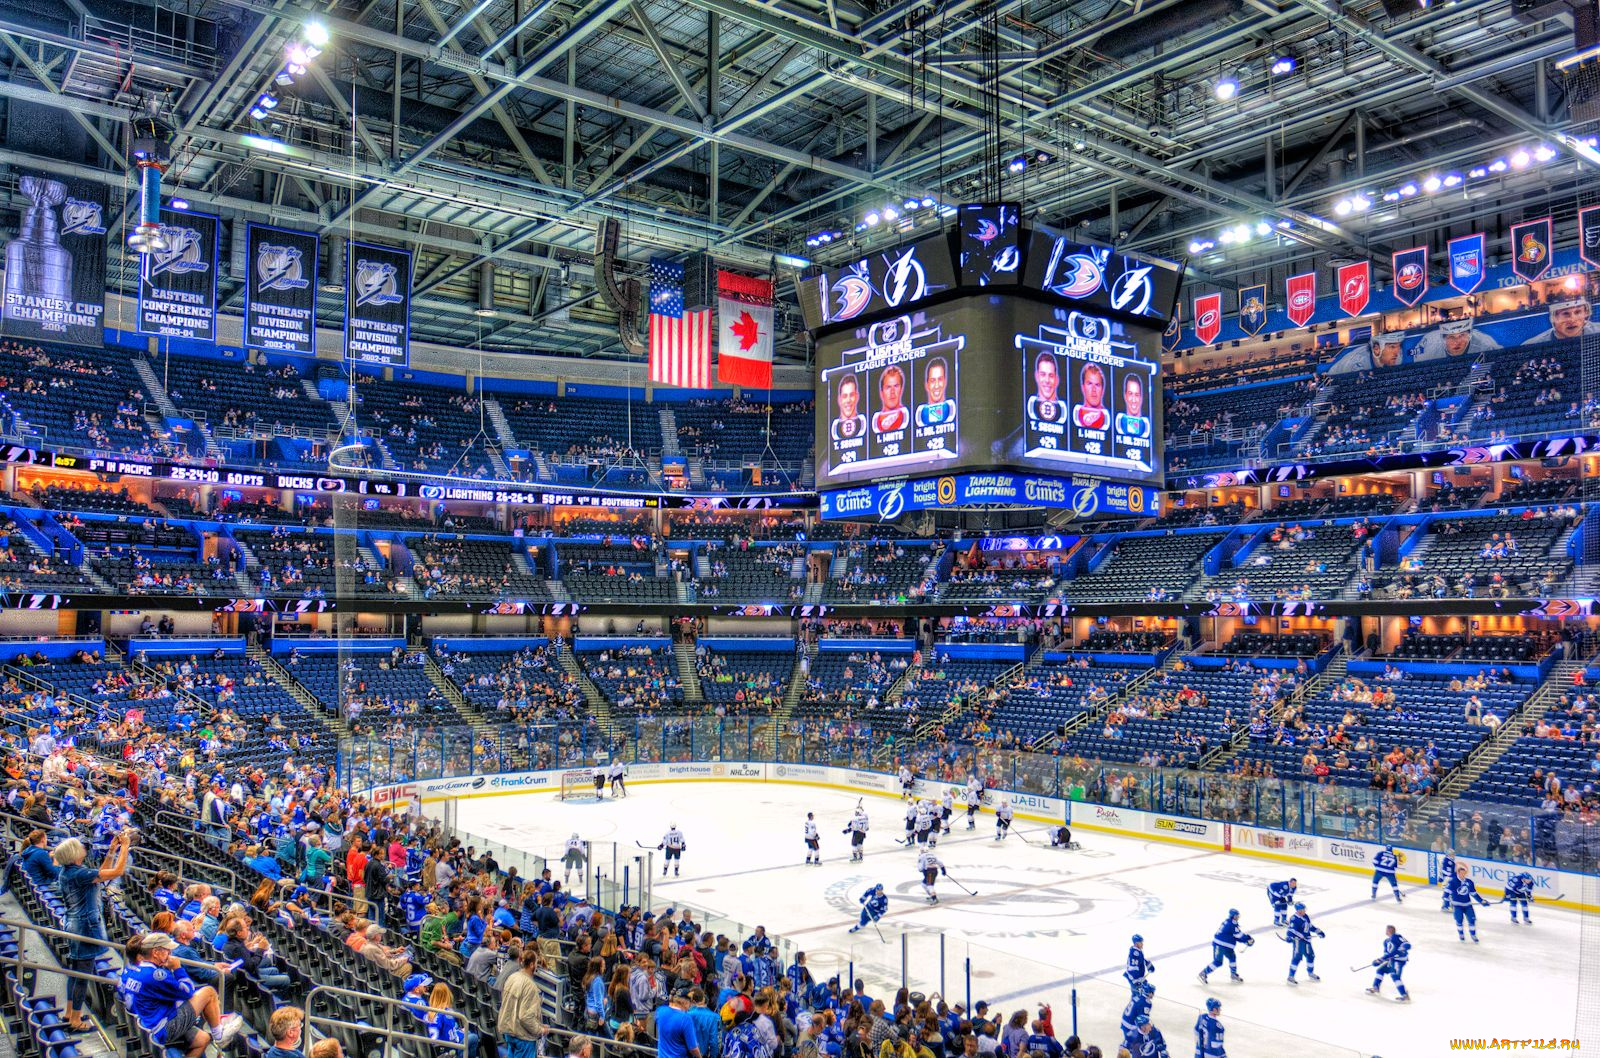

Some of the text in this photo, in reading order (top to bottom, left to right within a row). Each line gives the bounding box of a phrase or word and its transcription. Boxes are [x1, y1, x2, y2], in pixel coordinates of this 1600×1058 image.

[152, 288, 204, 305] EASTERN
[7, 293, 104, 316] STANLEY CUP
[142, 300, 212, 318] CONFERENCE
[250, 302, 311, 319] SOUTHEAST
[12, 306, 97, 327] CHAMPIONS
[145, 312, 209, 329] CHAMPIONS
[258, 315, 303, 330] DIVISION
[42, 322, 67, 333] 2004
[160, 326, 194, 337] 2003-04
[349, 317, 404, 334] SOUTHEAST
[250, 326, 310, 343] CHAMPIONS
[356, 330, 398, 345] DIVISION
[264, 340, 296, 351] 2003-04
[349, 341, 403, 356] CHAMPIONS
[361, 353, 391, 363] 2002-03
[855, 348, 926, 373] LEAGUE LEADERS
[1054, 346, 1125, 368] LEAGUE LEADERS
[54, 456, 76, 467] 4:57
[106, 461, 116, 472] IN
[119, 462, 153, 476] PACIFIC
[171, 467, 219, 482] 25-24-10
[278, 476, 314, 488] DUCKS
[969, 476, 1013, 487] TAMPA BAY
[913, 480, 936, 493] bright
[965, 486, 1016, 497] LIGHTNING
[1024, 479, 1065, 502] Times
[1106, 485, 1127, 497] bright
[446, 488, 493, 501] LIGHTNING
[496, 492, 534, 504] 26-26-6
[591, 496, 599, 506] IN
[601, 497, 645, 508] SOUTHEAST
[836, 494, 872, 512] Times
[913, 491, 936, 503] house
[1106, 495, 1127, 507] house
[669, 764, 689, 774] bright
[690, 765, 711, 774] house
[730, 769, 760, 777] NHL.COM
[501, 776, 547, 787] FrankCrum
[374, 785, 416, 803] GMC
[1011, 795, 1050, 809] JABIL
[1155, 818, 1207, 835] SUN SPORTS
[1331, 843, 1365, 860] Times
[1380, 856, 1396, 868] 27
